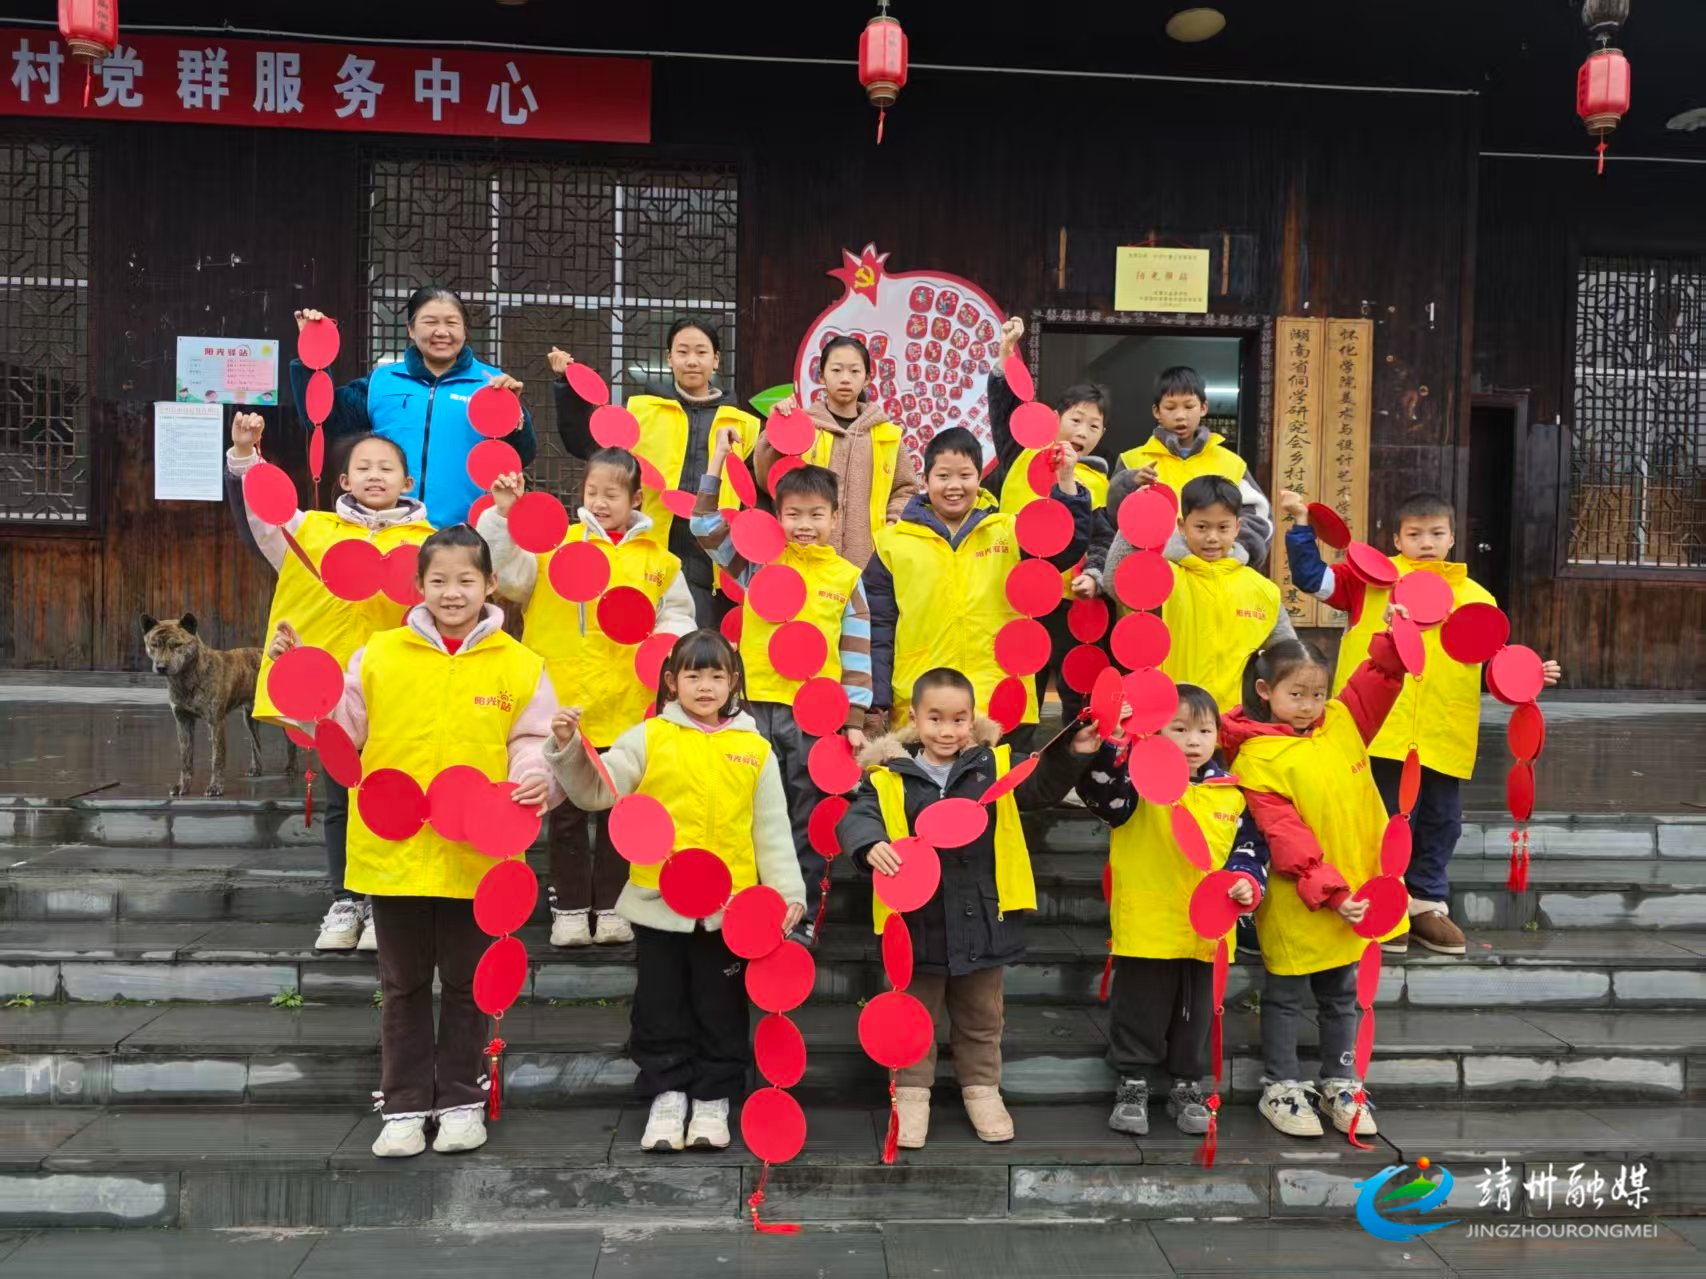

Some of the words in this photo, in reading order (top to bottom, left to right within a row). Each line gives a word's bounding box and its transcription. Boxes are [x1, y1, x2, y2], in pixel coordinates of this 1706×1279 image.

[11, 38, 539, 126] 村党群服务中心
